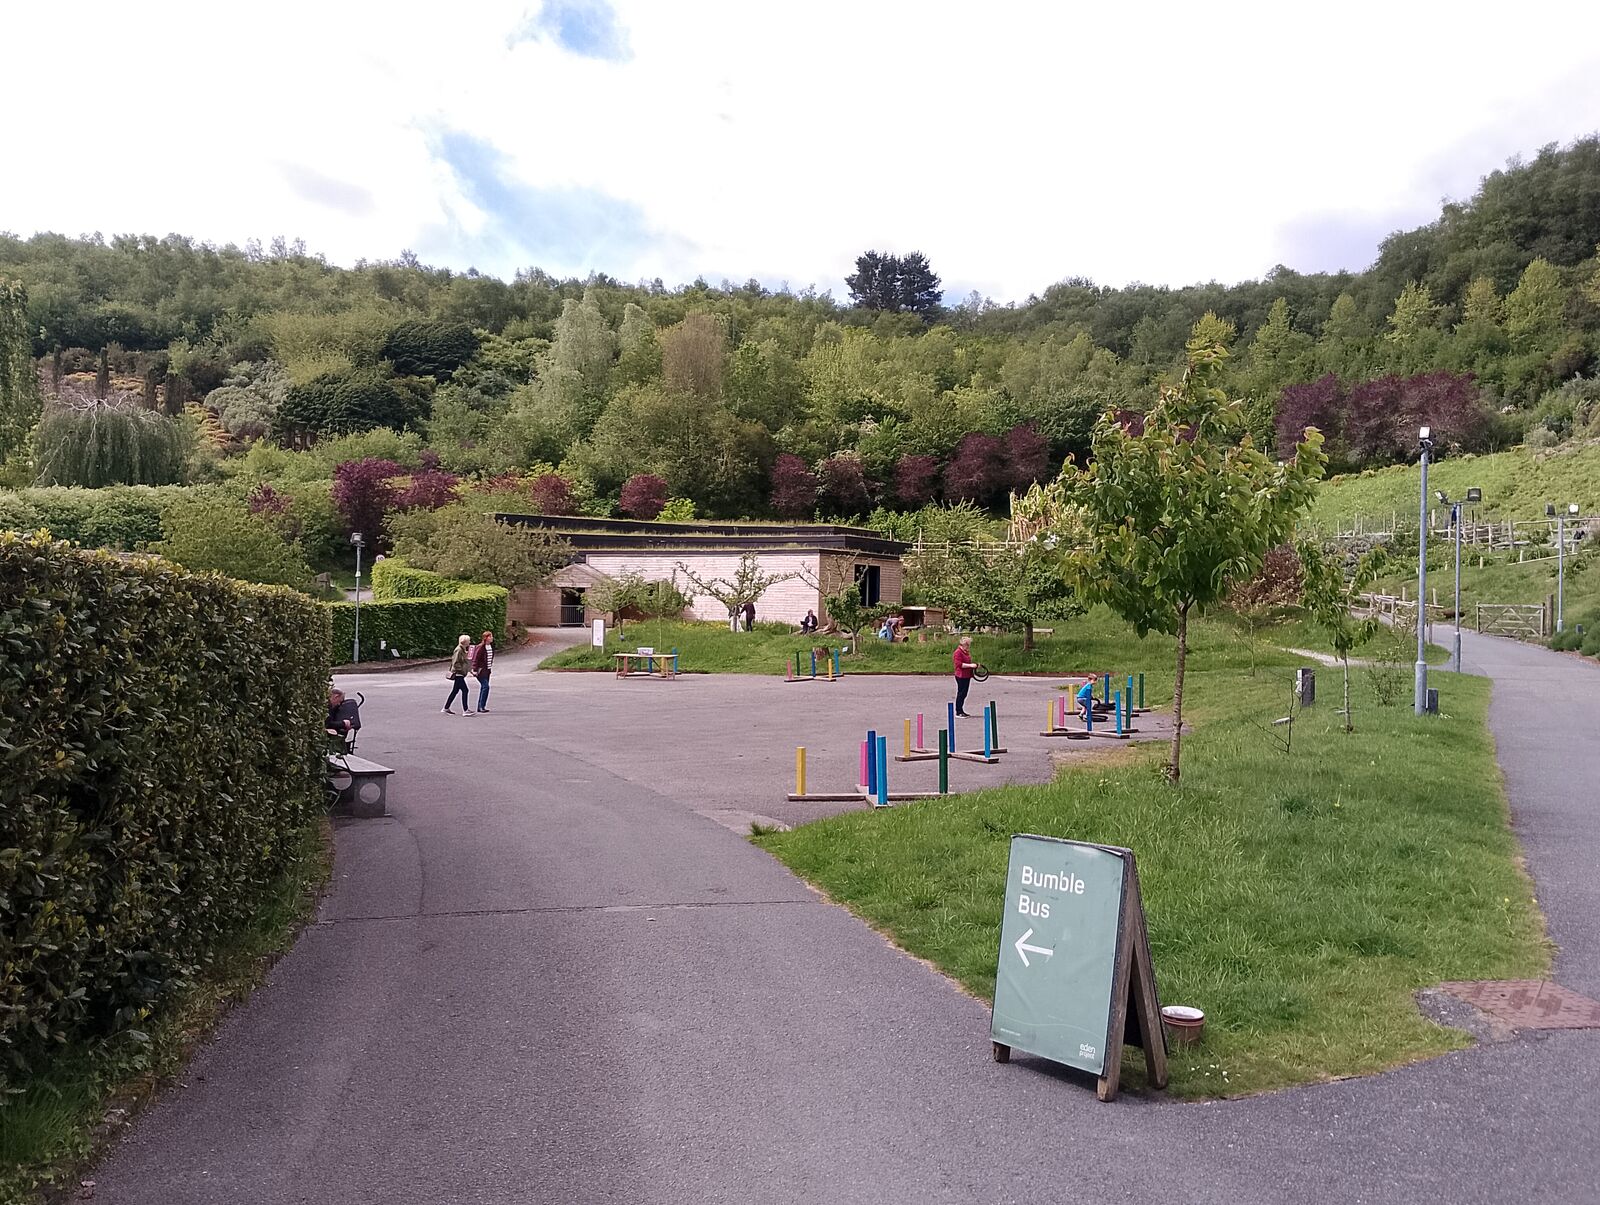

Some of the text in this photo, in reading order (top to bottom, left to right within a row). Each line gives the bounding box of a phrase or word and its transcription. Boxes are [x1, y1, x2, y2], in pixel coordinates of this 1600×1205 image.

[1021, 865, 1085, 895] Bumble
[1018, 894, 1050, 919] Bus
[1079, 1043, 1096, 1054] eden
